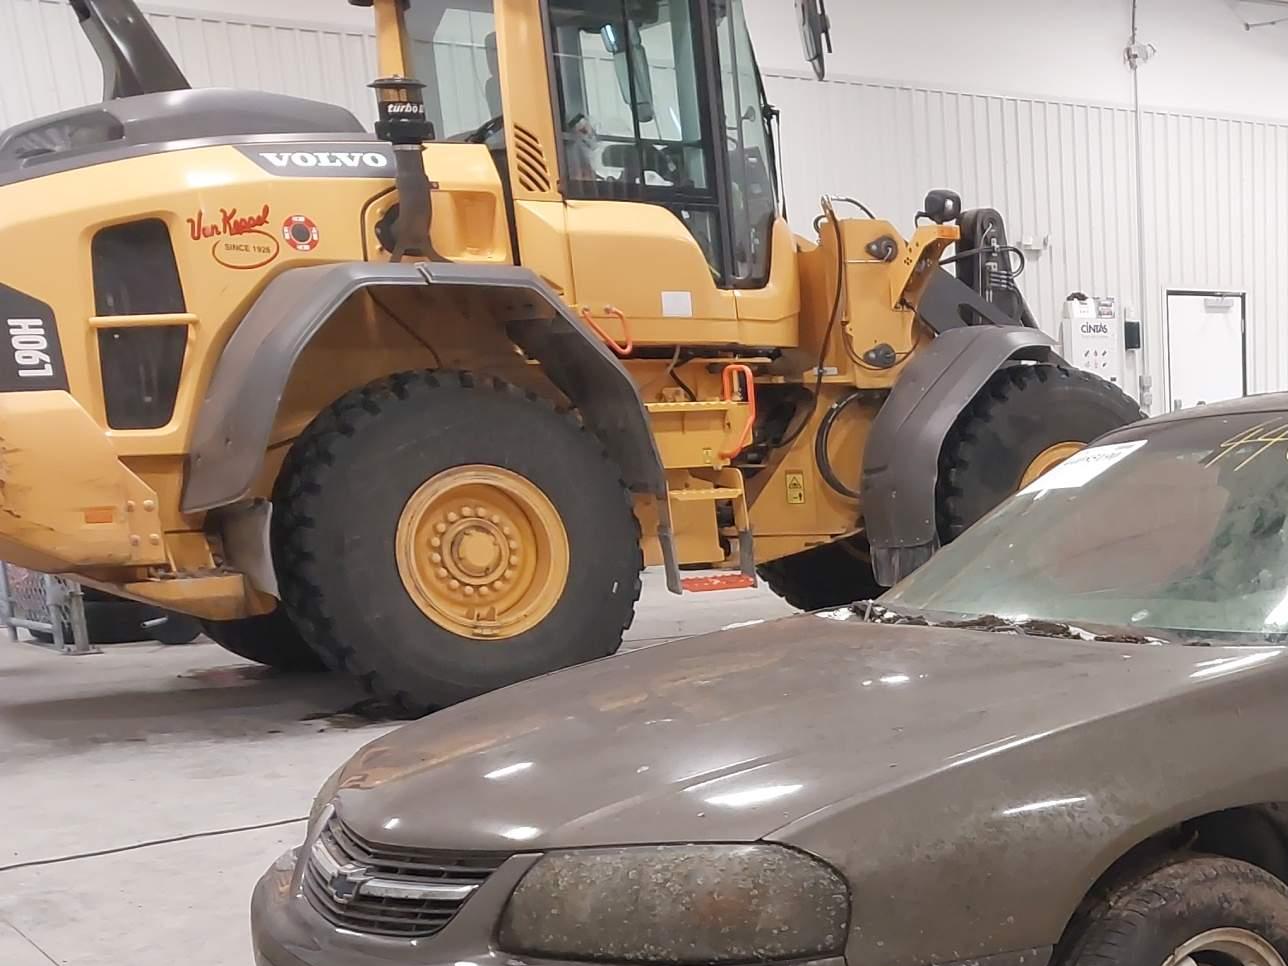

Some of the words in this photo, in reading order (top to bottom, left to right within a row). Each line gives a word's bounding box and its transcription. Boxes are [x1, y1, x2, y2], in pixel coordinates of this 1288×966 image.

[259, 152, 388, 167] VOLVO
[224, 243, 251, 253] SINCE
[7, 318, 54, 377] L90H
